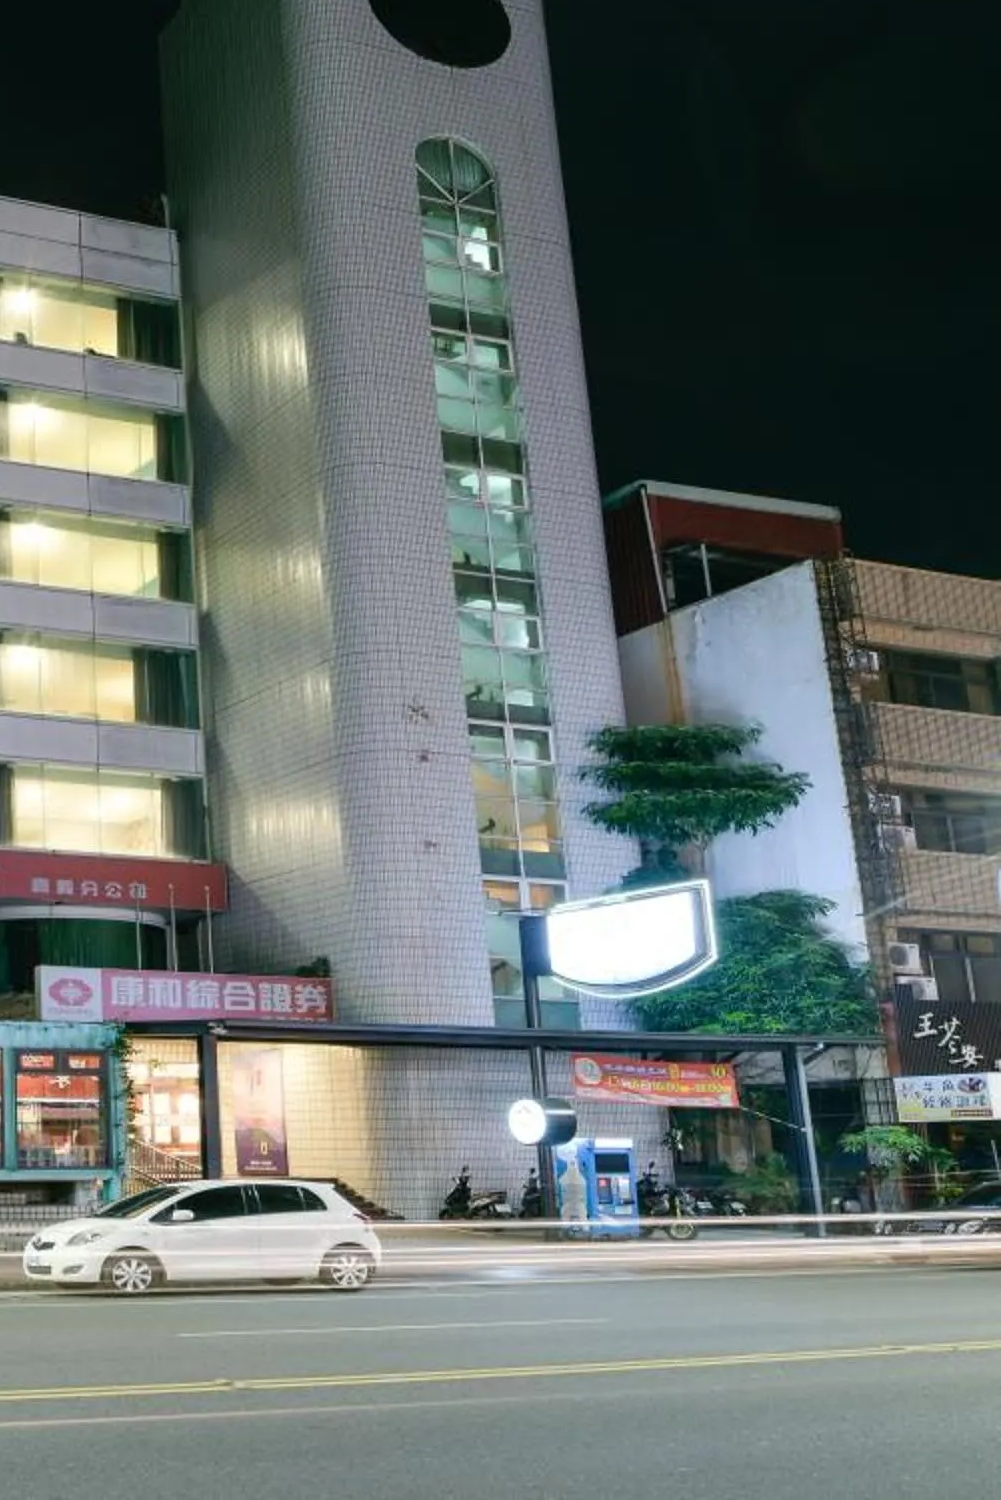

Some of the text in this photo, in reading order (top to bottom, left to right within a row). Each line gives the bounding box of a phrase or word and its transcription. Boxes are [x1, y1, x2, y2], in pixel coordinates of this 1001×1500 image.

[110, 976, 328, 1013] 康和綜合證券
